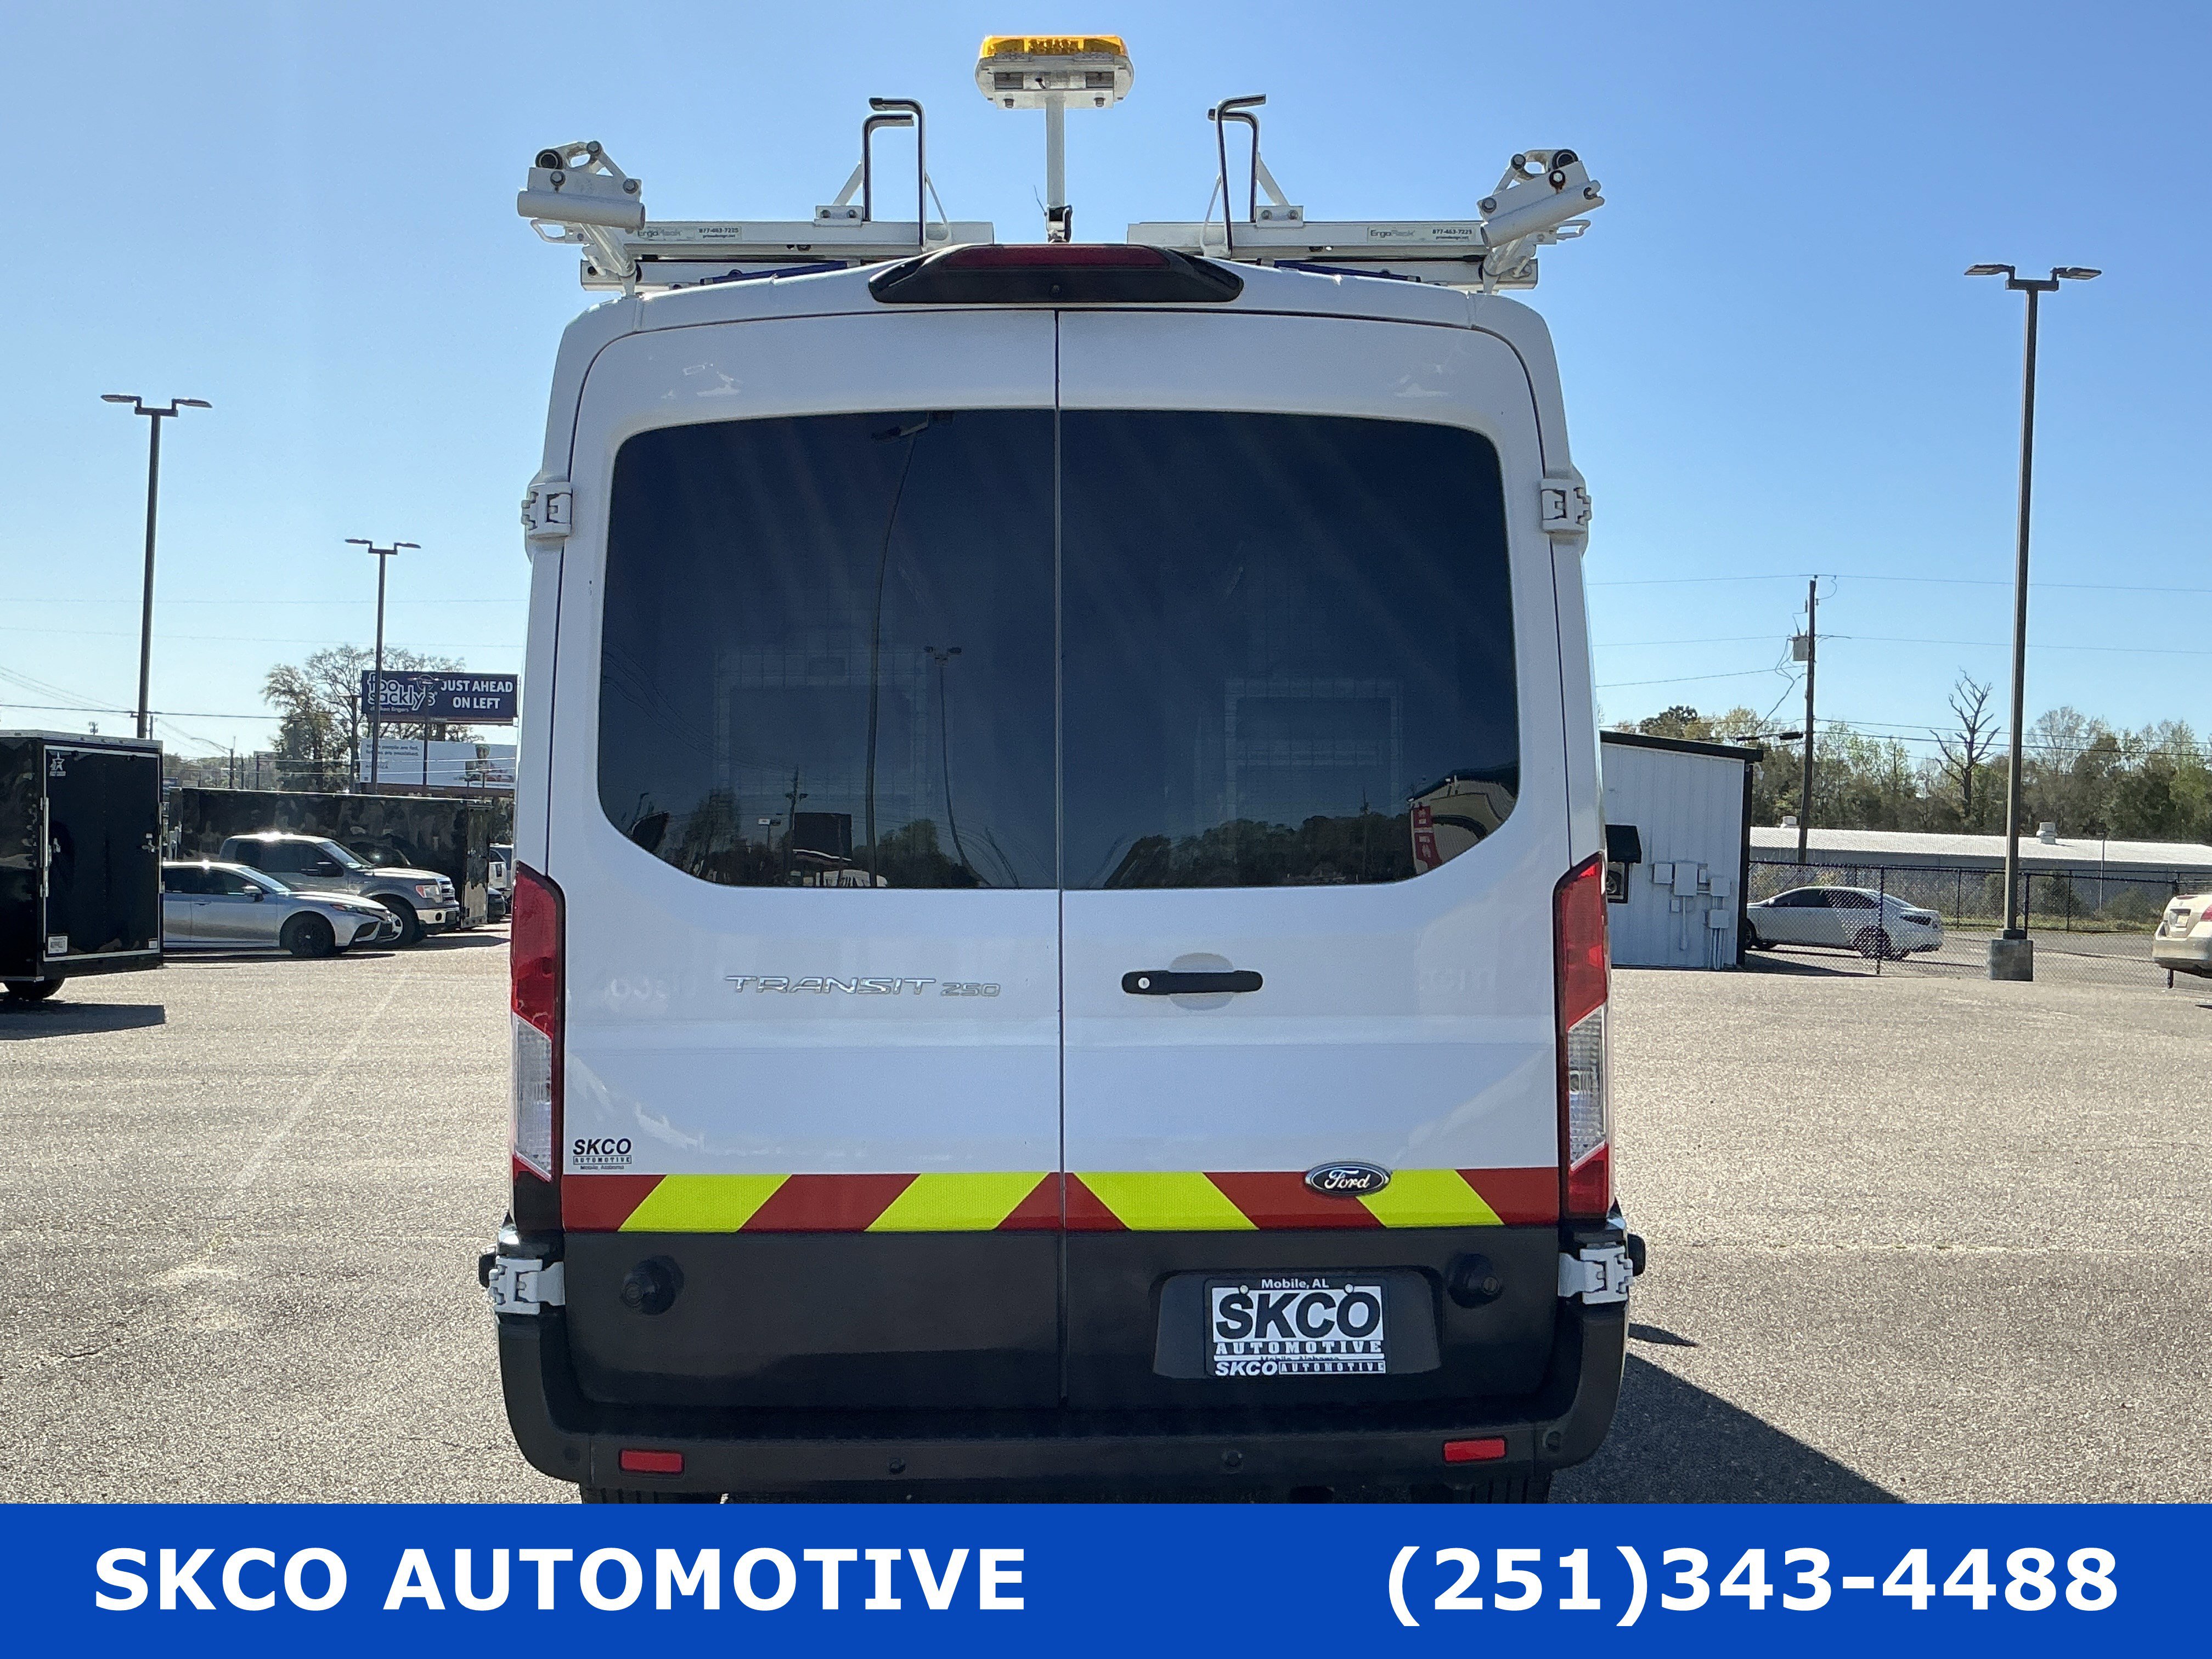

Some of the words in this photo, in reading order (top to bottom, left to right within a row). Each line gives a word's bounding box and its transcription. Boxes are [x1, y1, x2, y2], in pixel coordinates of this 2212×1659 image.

[441, 680, 470, 691] JUST
[472, 680, 514, 692] AHEAD
[367, 685, 436, 711] sacklys
[453, 696, 470, 709] ON
[473, 697, 500, 709] LEFT
[725, 975, 936, 996] TRANSIT
[940, 982, 1001, 997] 250
[573, 1138, 631, 1155] SKCO
[1324, 1169, 1371, 1189] Ford
[1262, 1278, 1310, 1289] Mobile,
[1312, 1278, 1330, 1288] AL
[1216, 1291, 1381, 1340] SKCO
[1215, 1341, 1382, 1355] AUTOMOTIVE
[1215, 1361, 1278, 1376] SKCO
[1281, 1362, 1384, 1372] AUTOMOTIVE
